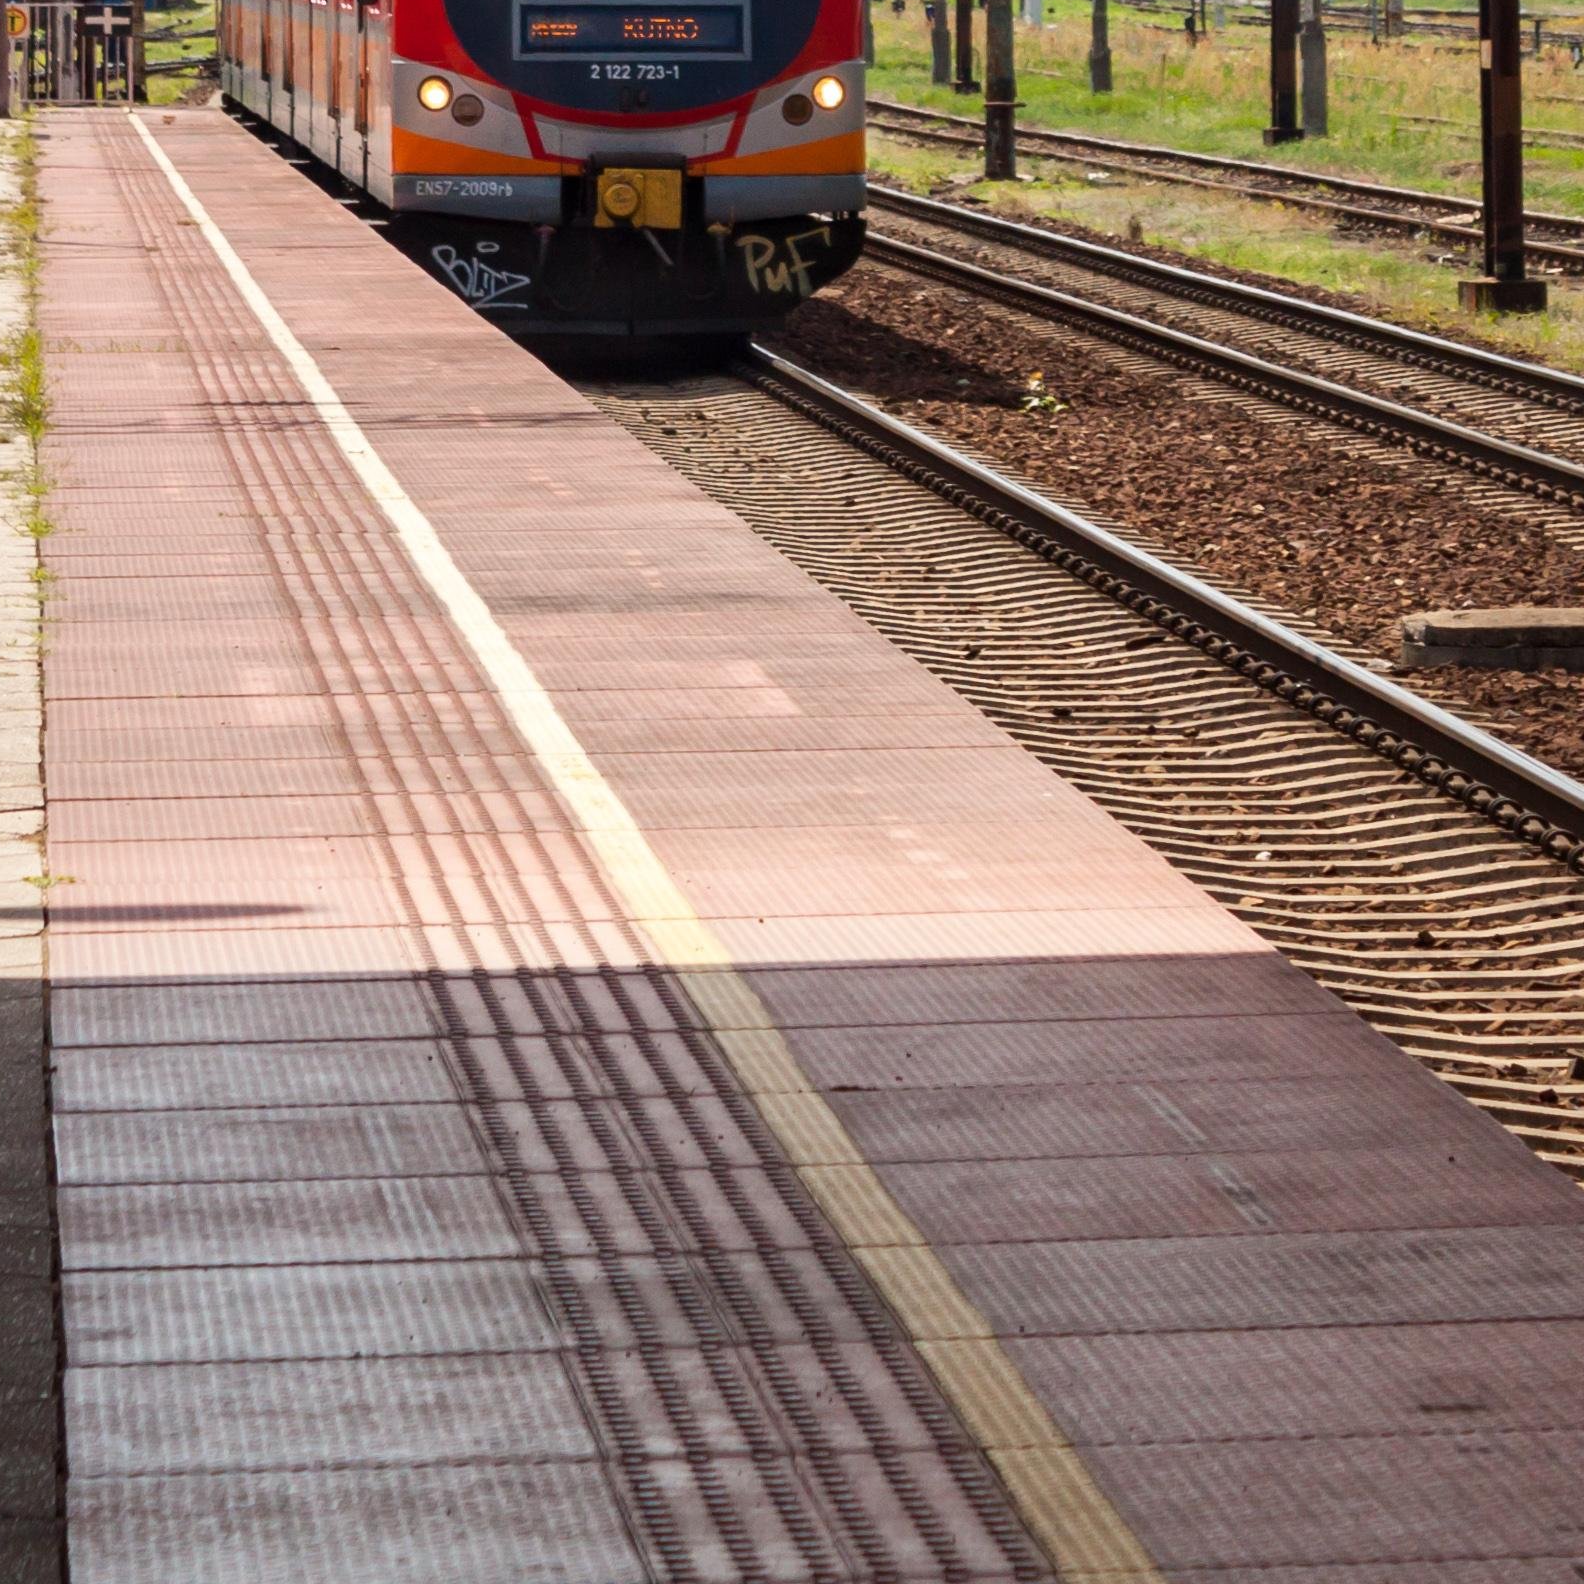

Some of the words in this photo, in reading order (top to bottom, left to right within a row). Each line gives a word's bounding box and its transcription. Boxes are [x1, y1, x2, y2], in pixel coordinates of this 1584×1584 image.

[590, 64, 600, 79] 2
[605, 64, 631, 79] 122
[636, 64, 680, 79] 723-1
